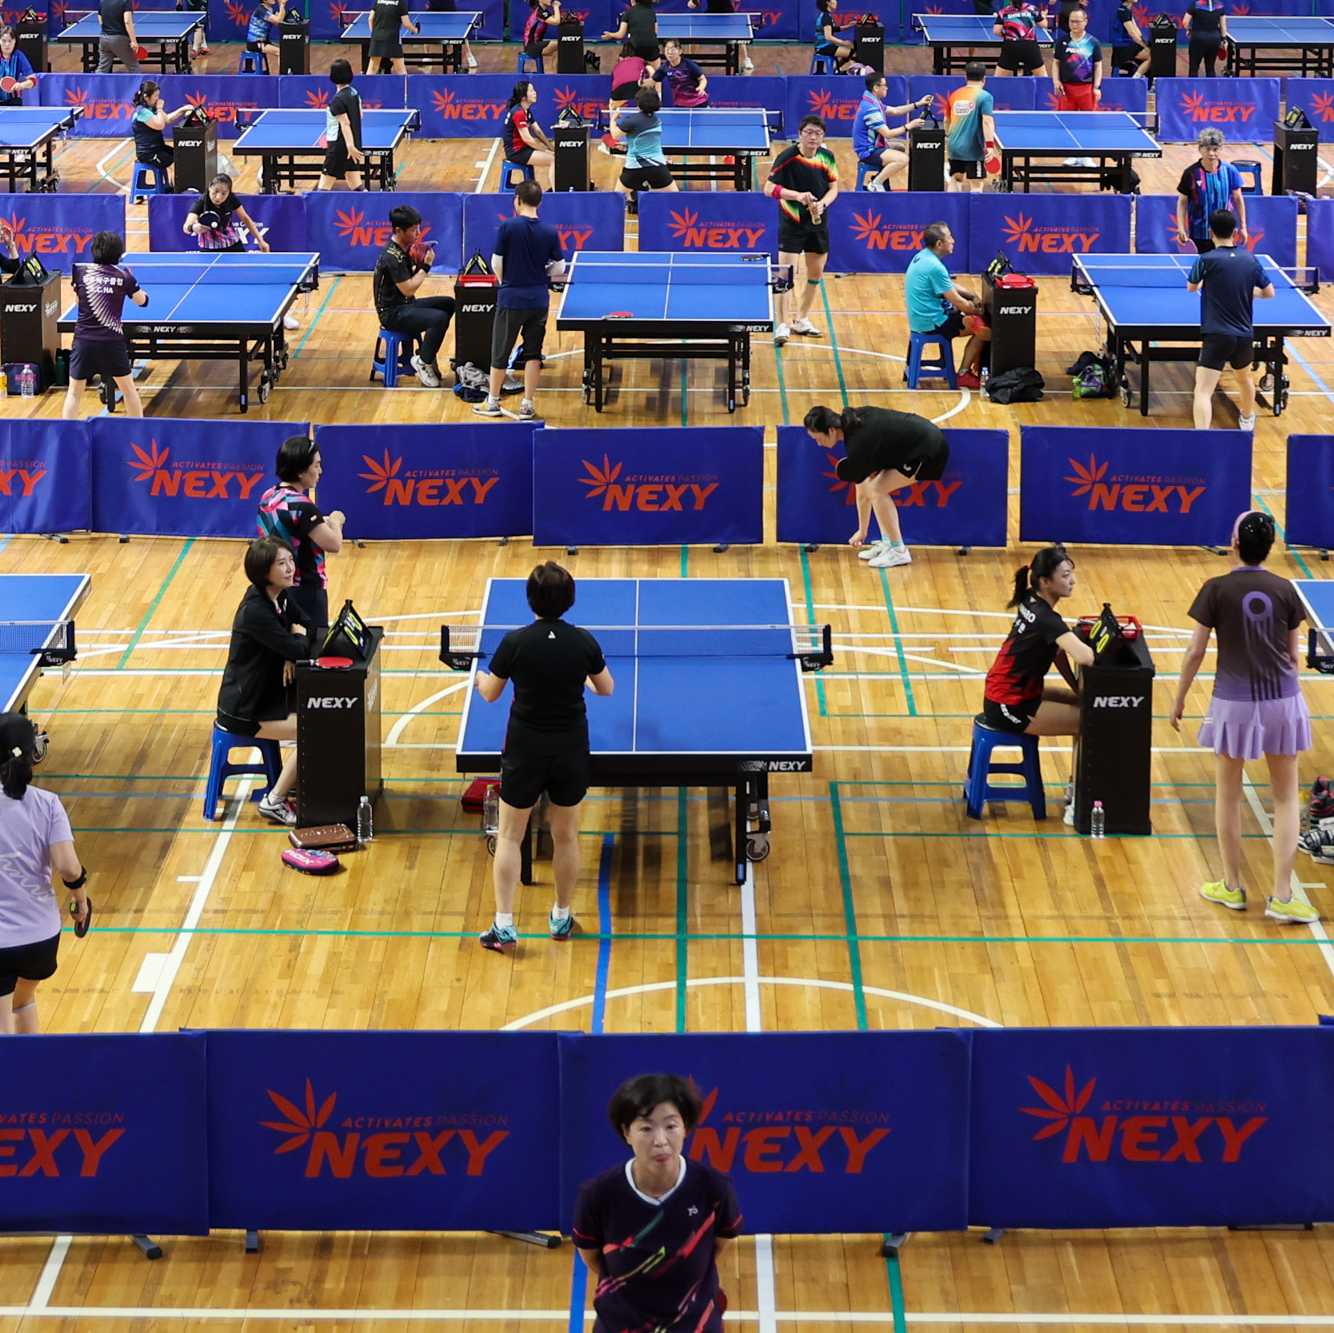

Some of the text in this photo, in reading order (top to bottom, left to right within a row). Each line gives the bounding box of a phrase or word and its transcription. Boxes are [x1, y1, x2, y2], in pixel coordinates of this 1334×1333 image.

[443, 104, 507, 119] NEXY
[1192, 106, 1256, 122] NEXY
[683, 229, 766, 248] NEXY
[1017, 233, 1100, 253] NEXY
[746, 324, 770, 332] NEXY
[404, 469, 456, 477] ACTIVATES
[383, 477, 500, 506] NEXY
[602, 483, 719, 512] NEXY
[1088, 483, 1207, 513] NEXY
[307, 697, 358, 709] NEXY
[1093, 696, 1144, 708] NEXY
[768, 761, 806, 771] NEXY
[51, 1112, 124, 1125] PASSION
[342, 1115, 509, 1128] ACTIVATES PASSION
[1062, 1115, 1268, 1163] NEXY
[304, 1129, 510, 1179] NEXY
[688, 1126, 891, 1174] NEXY
